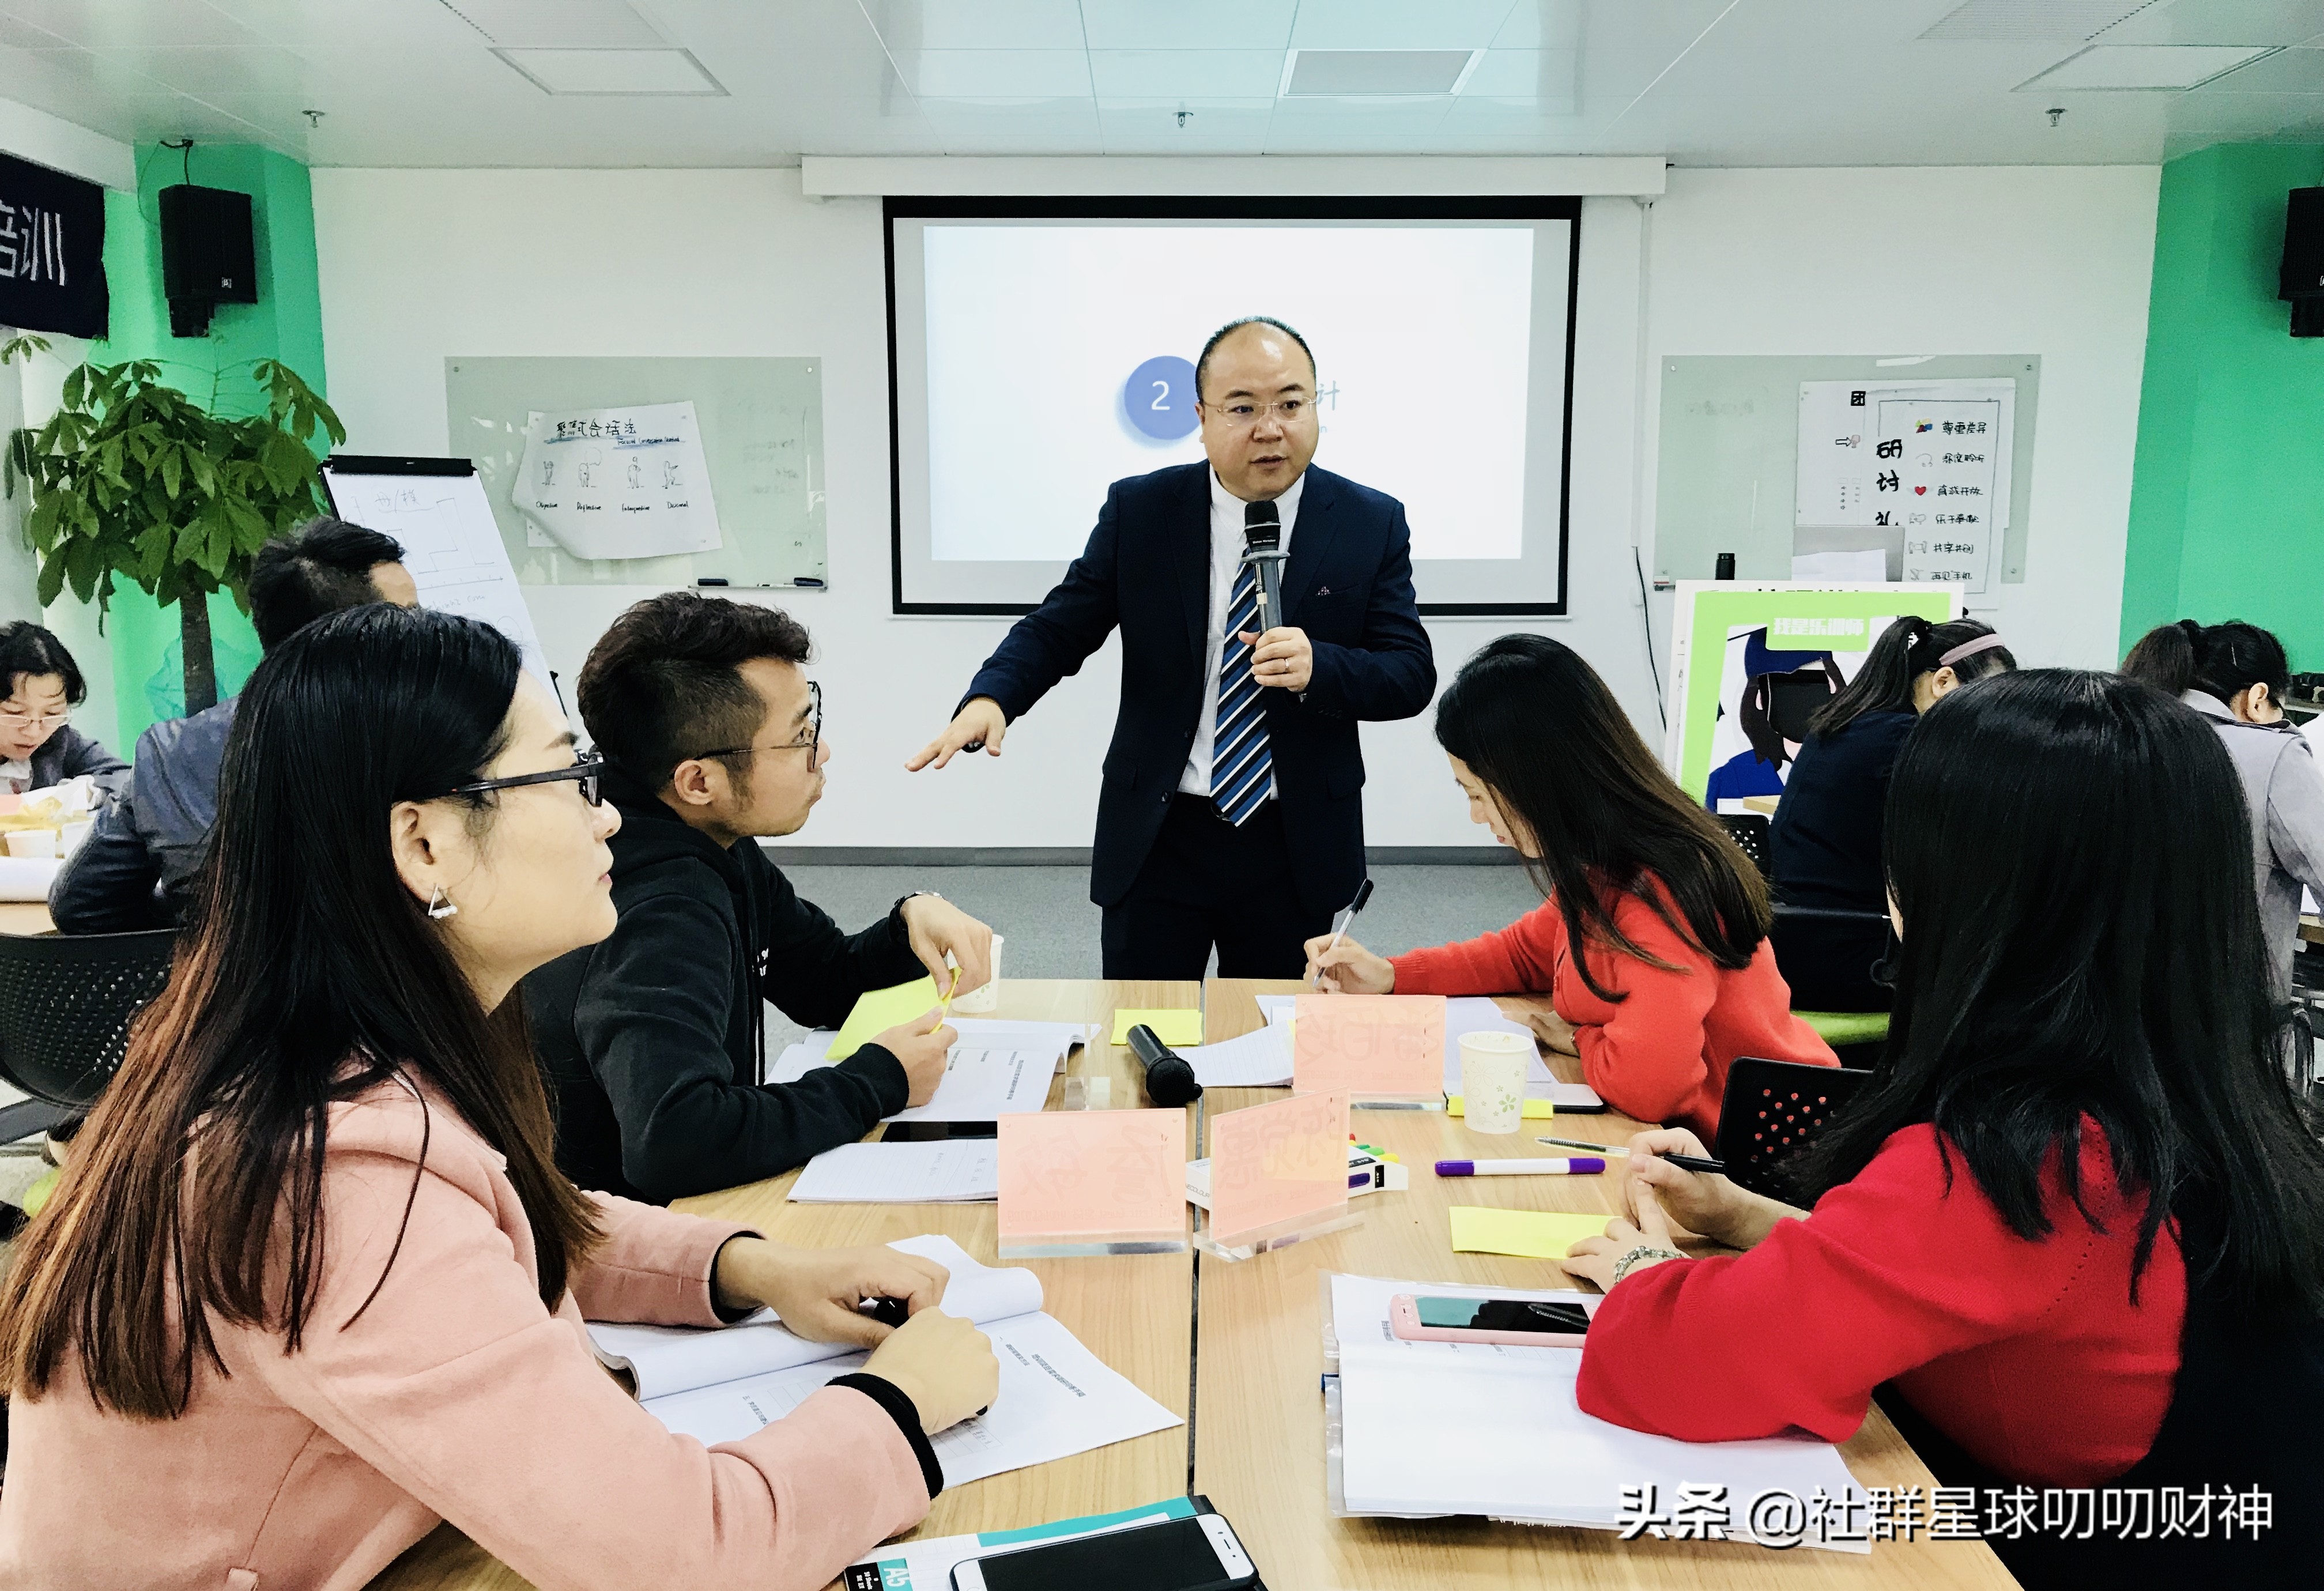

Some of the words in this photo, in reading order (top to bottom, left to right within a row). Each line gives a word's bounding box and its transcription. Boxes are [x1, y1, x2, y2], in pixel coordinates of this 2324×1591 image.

[1152, 380, 1169, 410] 2
[1317, 380, 1340, 411] 计
[1850, 390, 1866, 406] 团
[1941, 420, 1987, 436] 尊重差异
[1933, 541, 1974, 555] 共享共创
[1930, 570, 1973, 580] 再见手机
[1773, 617, 1864, 636] 我是乐训师
[883, 1567, 910, 1587] A5
